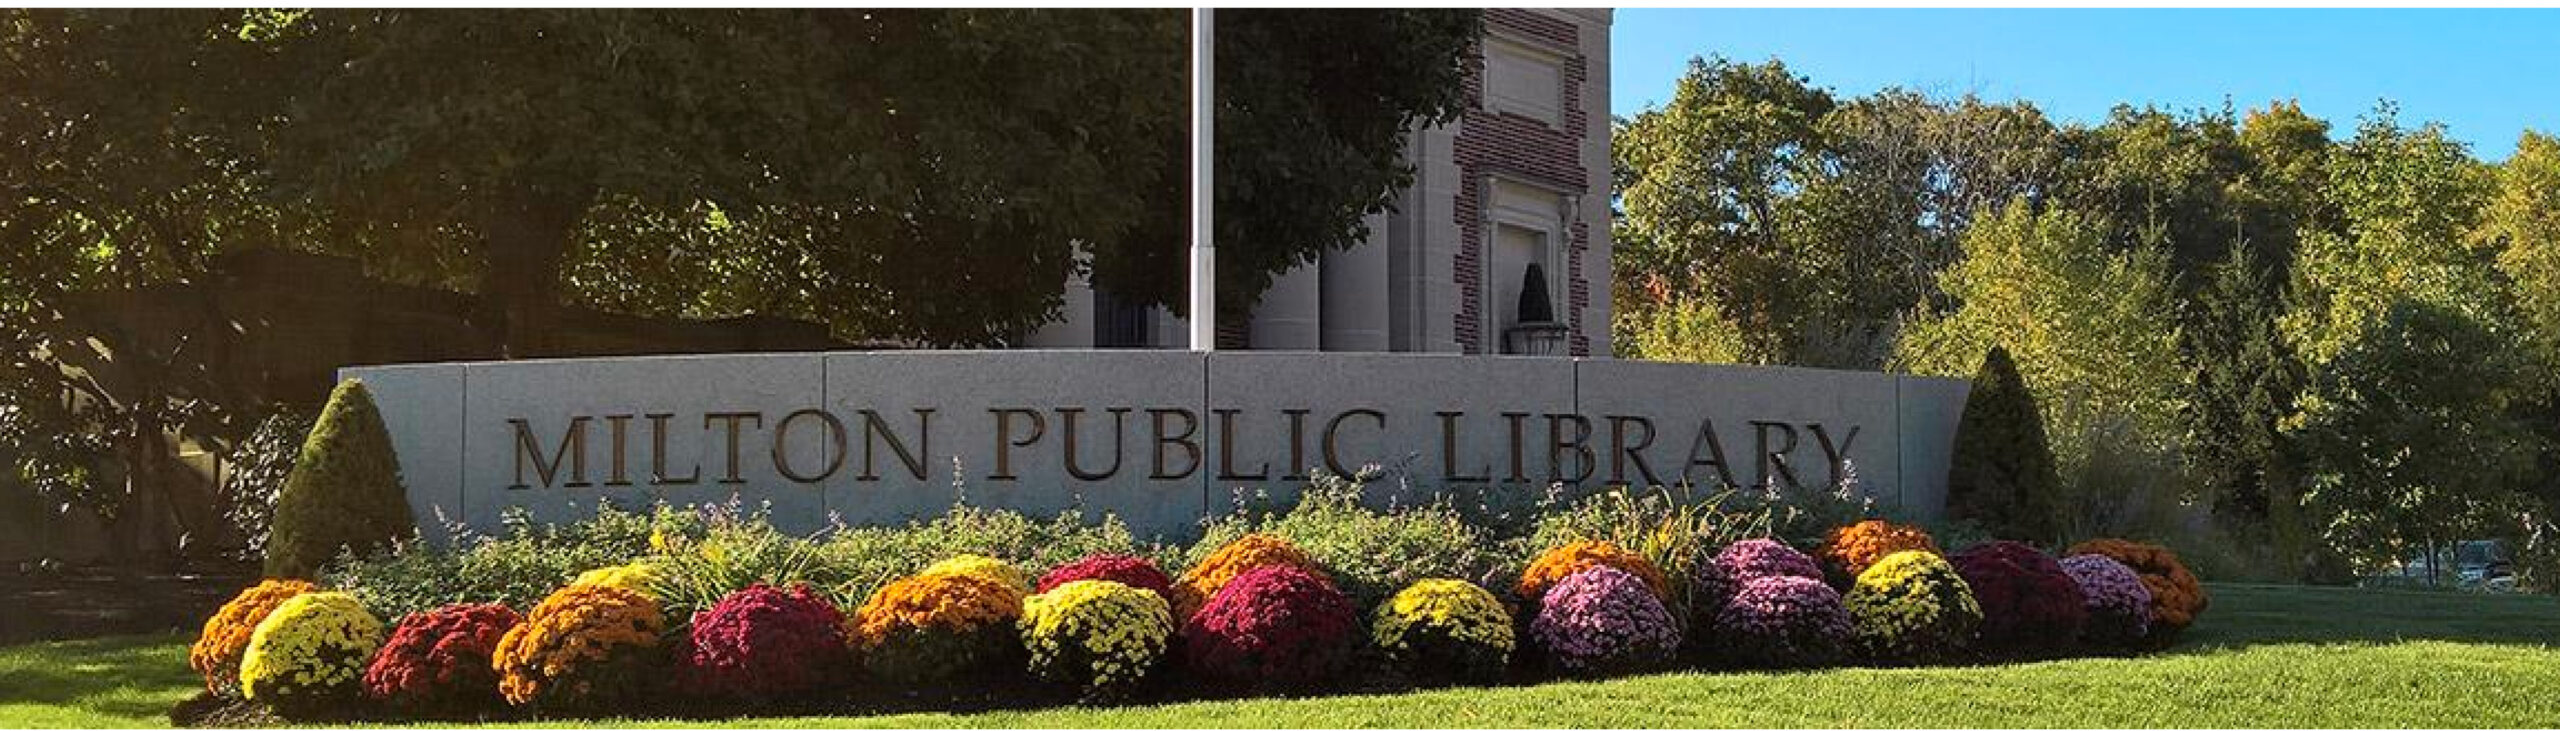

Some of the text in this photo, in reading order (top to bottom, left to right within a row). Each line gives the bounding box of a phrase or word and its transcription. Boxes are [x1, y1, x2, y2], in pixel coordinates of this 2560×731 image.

[506, 407, 1861, 492] MILTON PUBLIC LIBRARY
